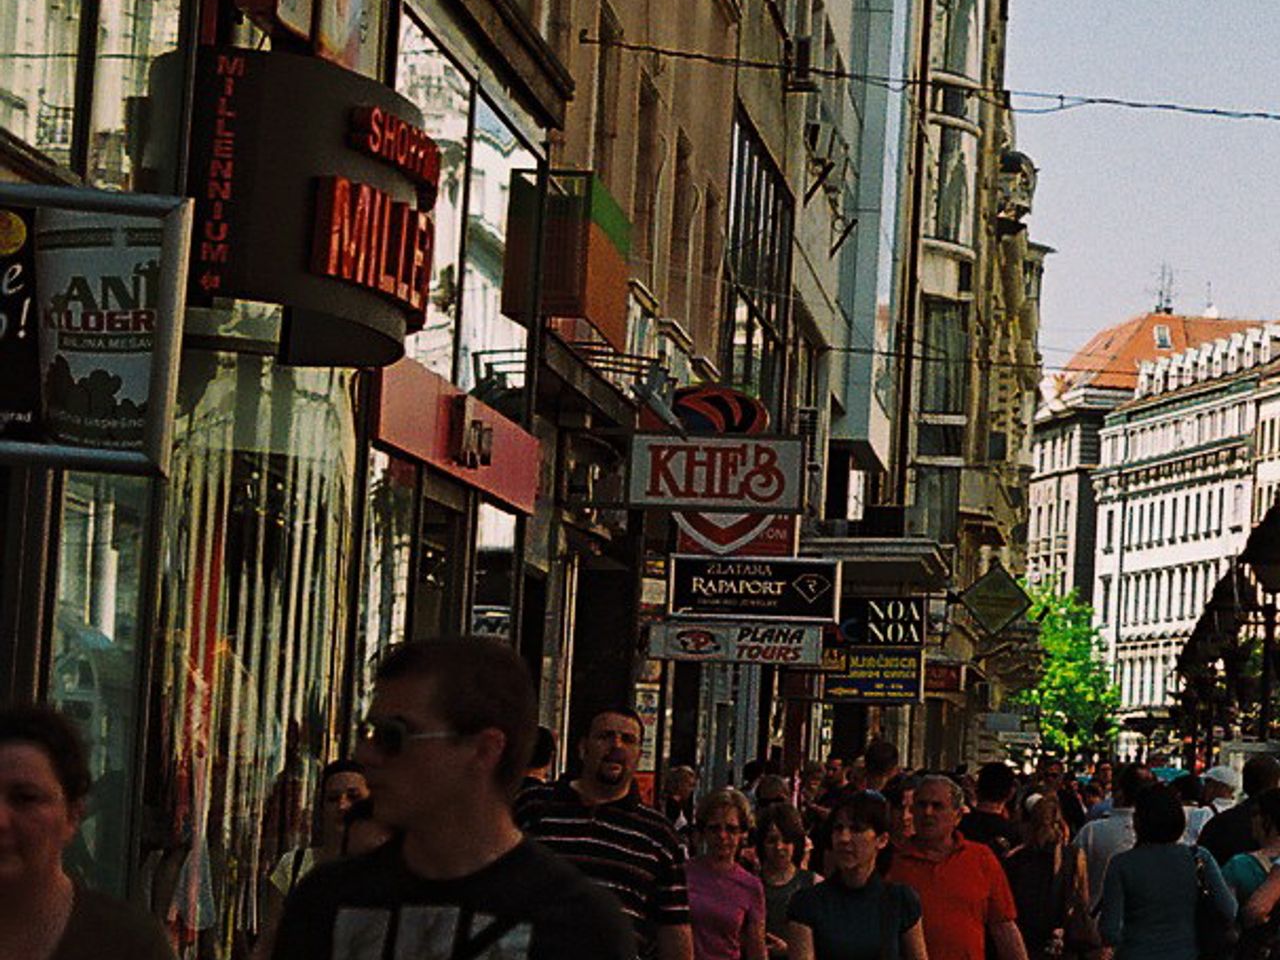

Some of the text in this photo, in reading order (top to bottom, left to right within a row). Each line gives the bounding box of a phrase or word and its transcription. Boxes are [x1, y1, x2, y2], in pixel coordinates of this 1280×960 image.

[201, 53, 246, 263] MILLENNIUM
[706, 563, 773, 576] ZLATARA
[691, 577, 787, 597] RAPAPORT
[867, 599, 921, 621] NOA
[736, 626, 806, 644] PLANA
[867, 622, 921, 644] NOA
[735, 644, 803, 662] TOURS
